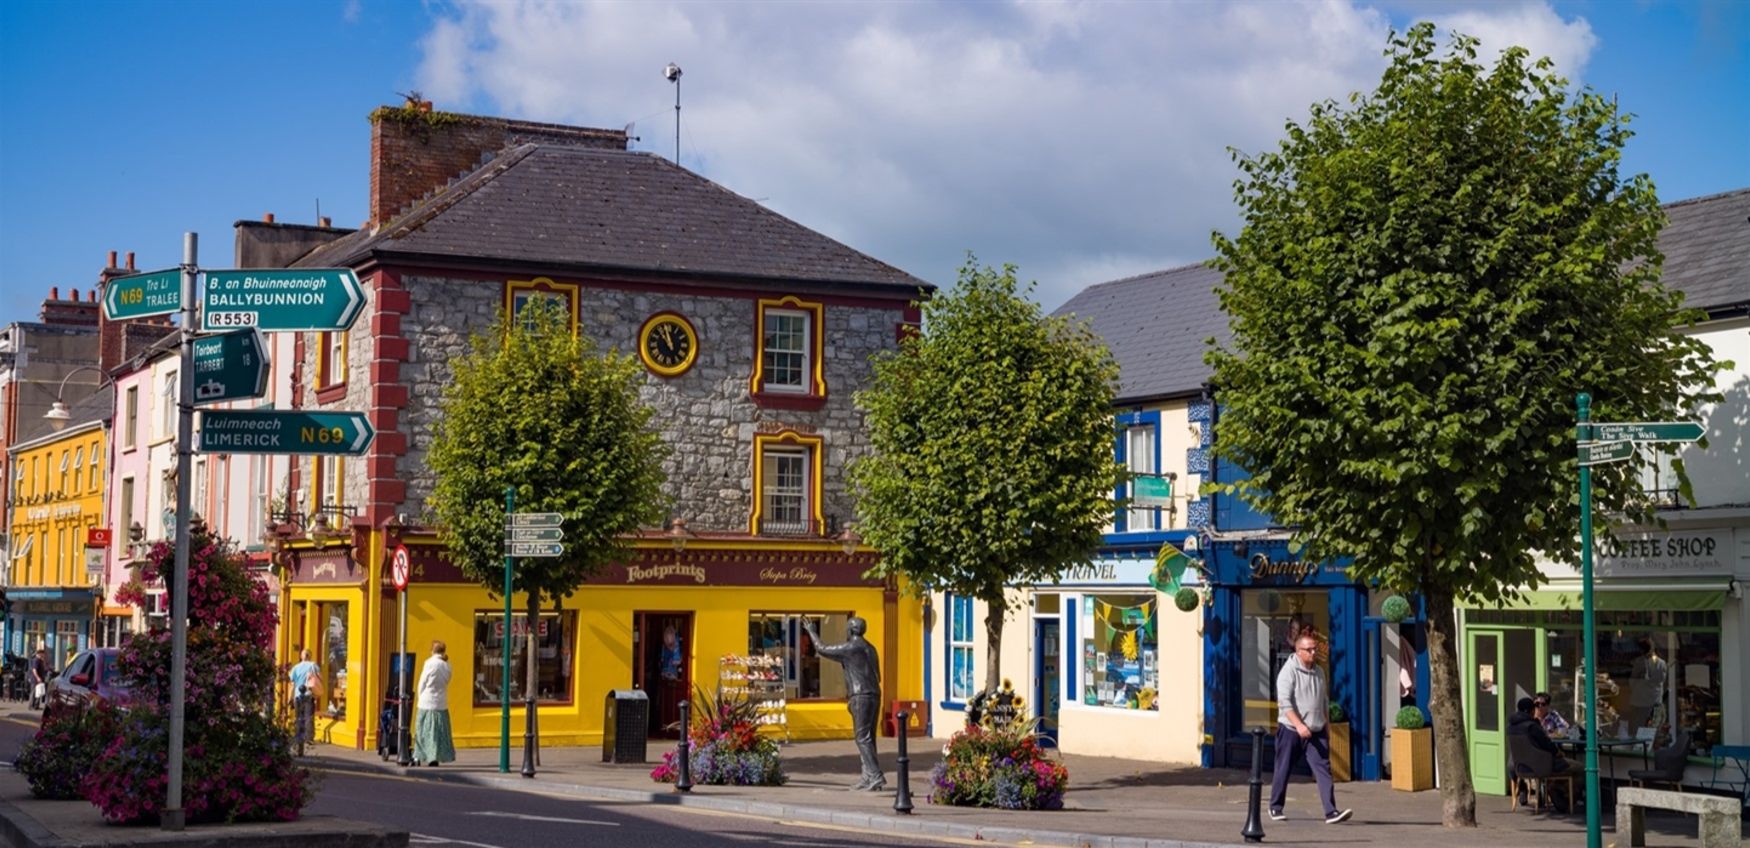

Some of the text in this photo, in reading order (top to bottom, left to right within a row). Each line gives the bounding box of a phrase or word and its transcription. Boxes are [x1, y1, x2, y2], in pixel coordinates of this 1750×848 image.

[209, 277, 221, 290] B.
[225, 279, 239, 289] an
[146, 291, 179, 307] TRALEE
[209, 293, 324, 306] BALLYBUNNION
[206, 417, 282, 430] Luimneach
[205, 433, 280, 446] LIMERICK
[1667, 537, 1717, 558] SHOP
[626, 561, 706, 584] Footprints
